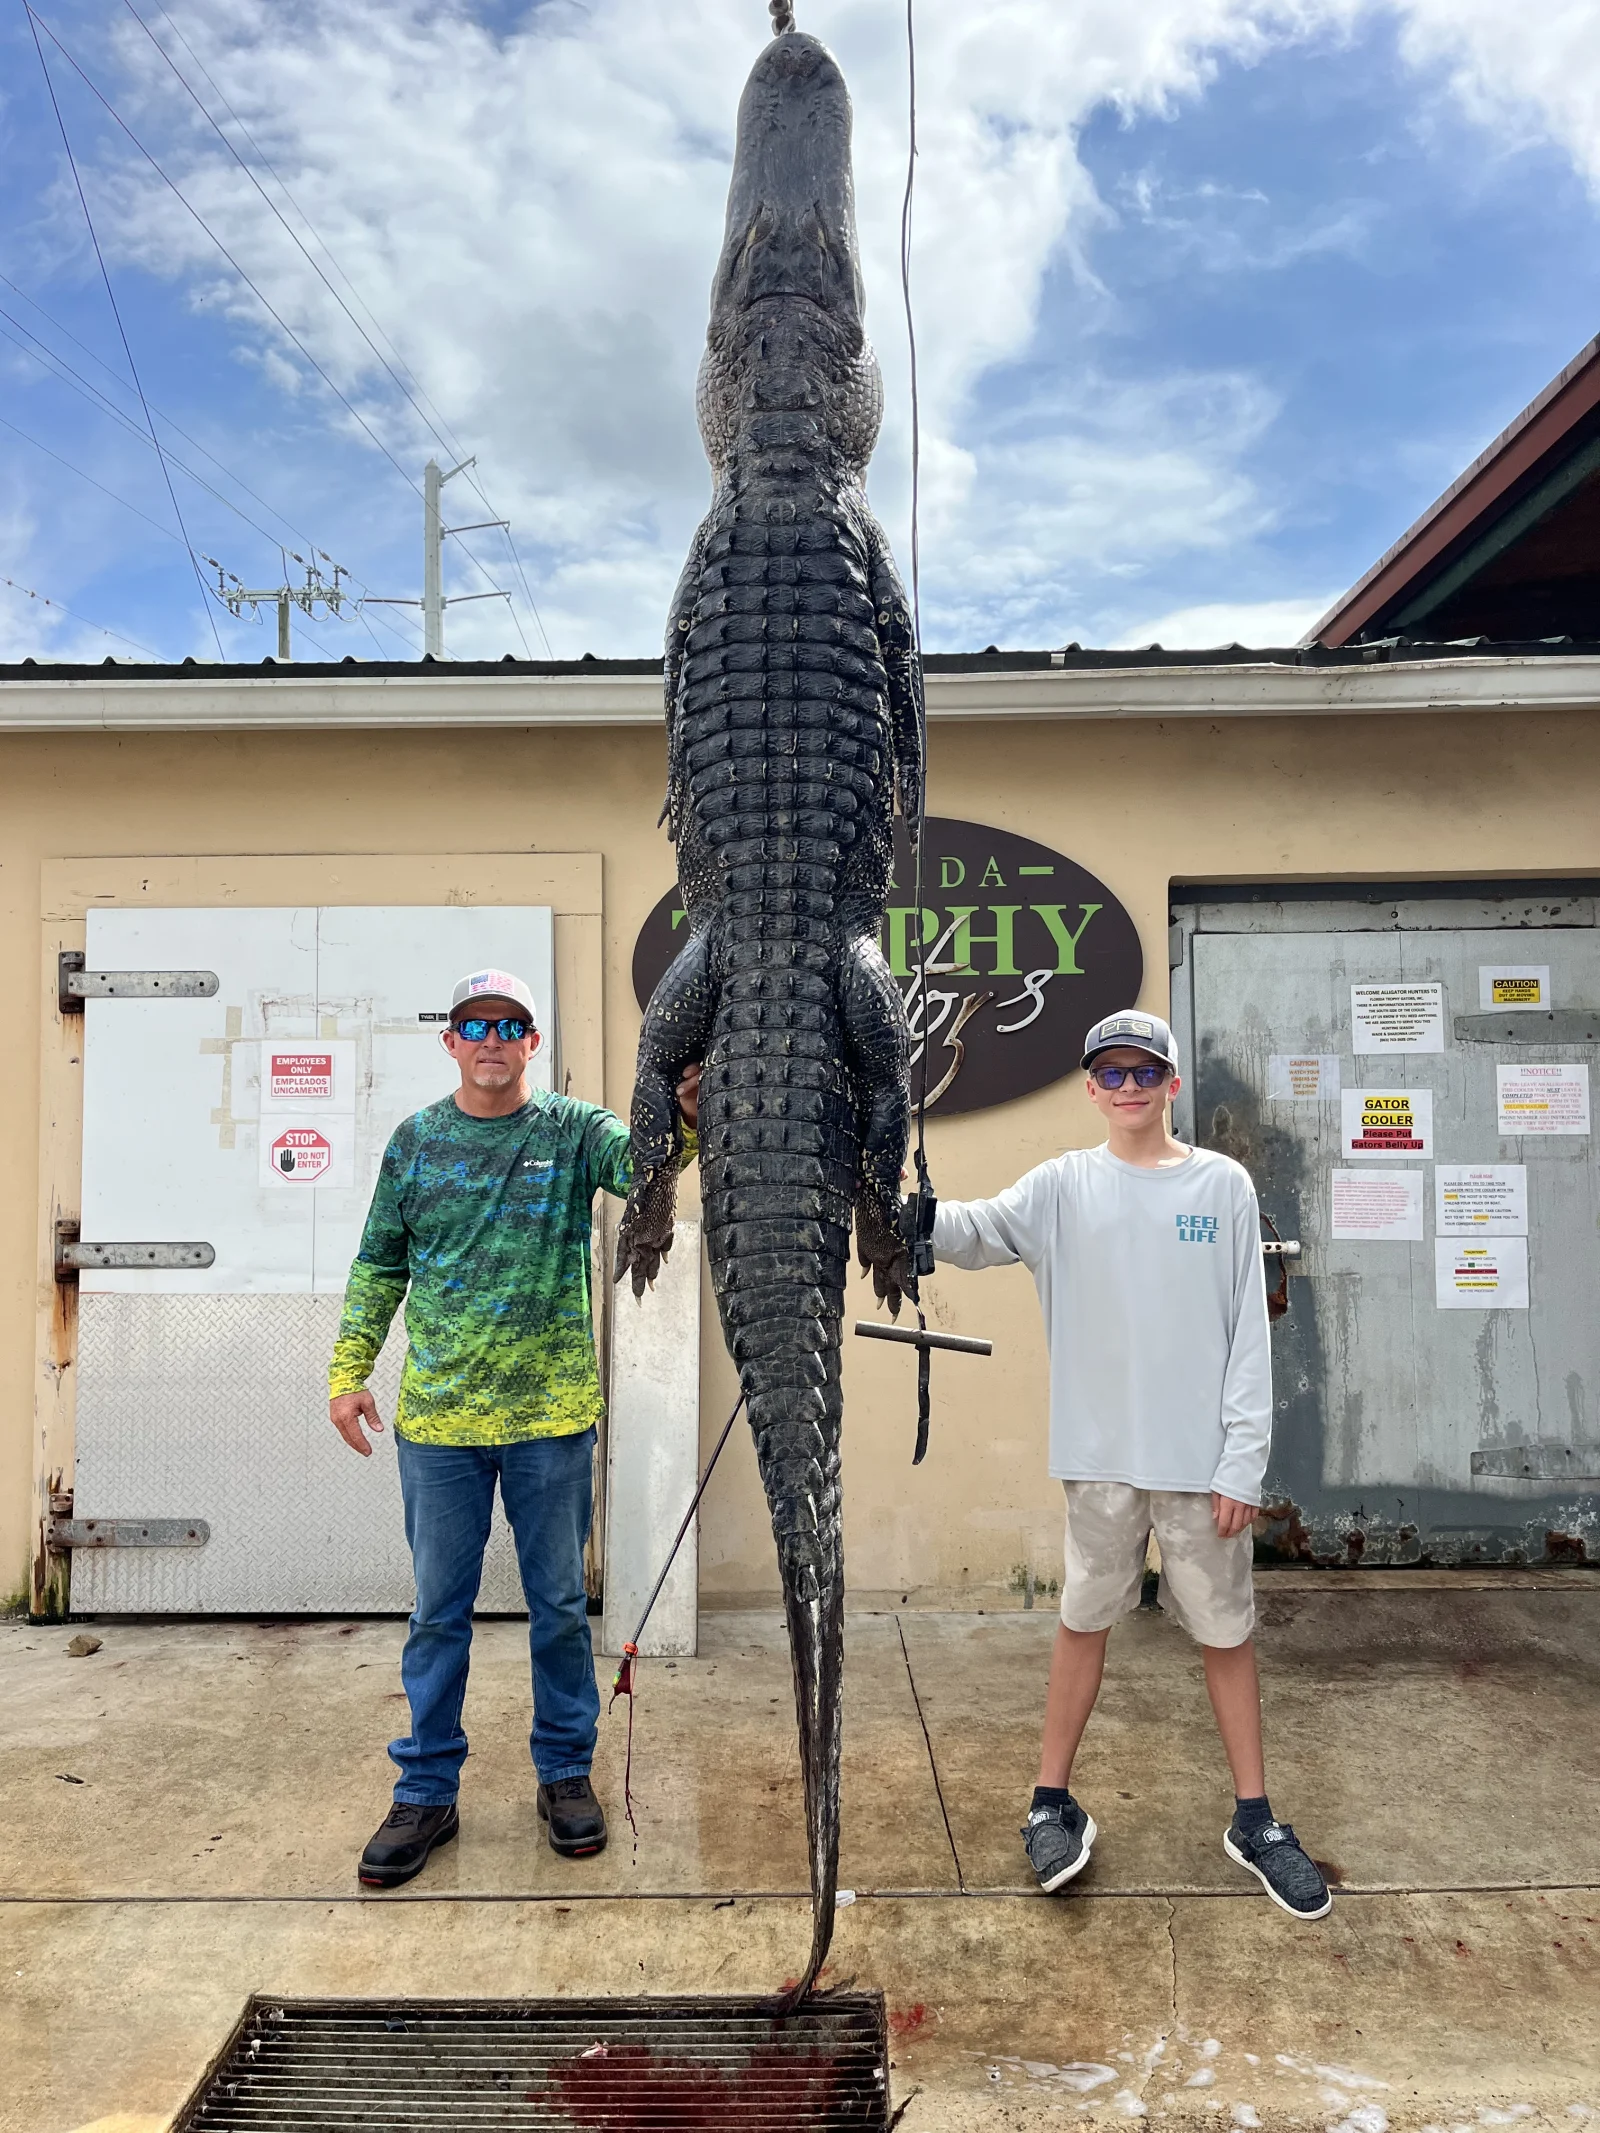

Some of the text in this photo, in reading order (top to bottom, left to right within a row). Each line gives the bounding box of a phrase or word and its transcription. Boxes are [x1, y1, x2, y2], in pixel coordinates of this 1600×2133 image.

[1102, 1020, 1150, 1036] PFG
[1365, 1100, 1409, 1109] GATOR
[1362, 1116, 1413, 1125] COOLER
[286, 1133, 317, 1145] STOP
[1411, 1141, 1423, 1149] Up
[1176, 1214, 1219, 1230] REEL
[1179, 1228, 1216, 1243] LIFE
